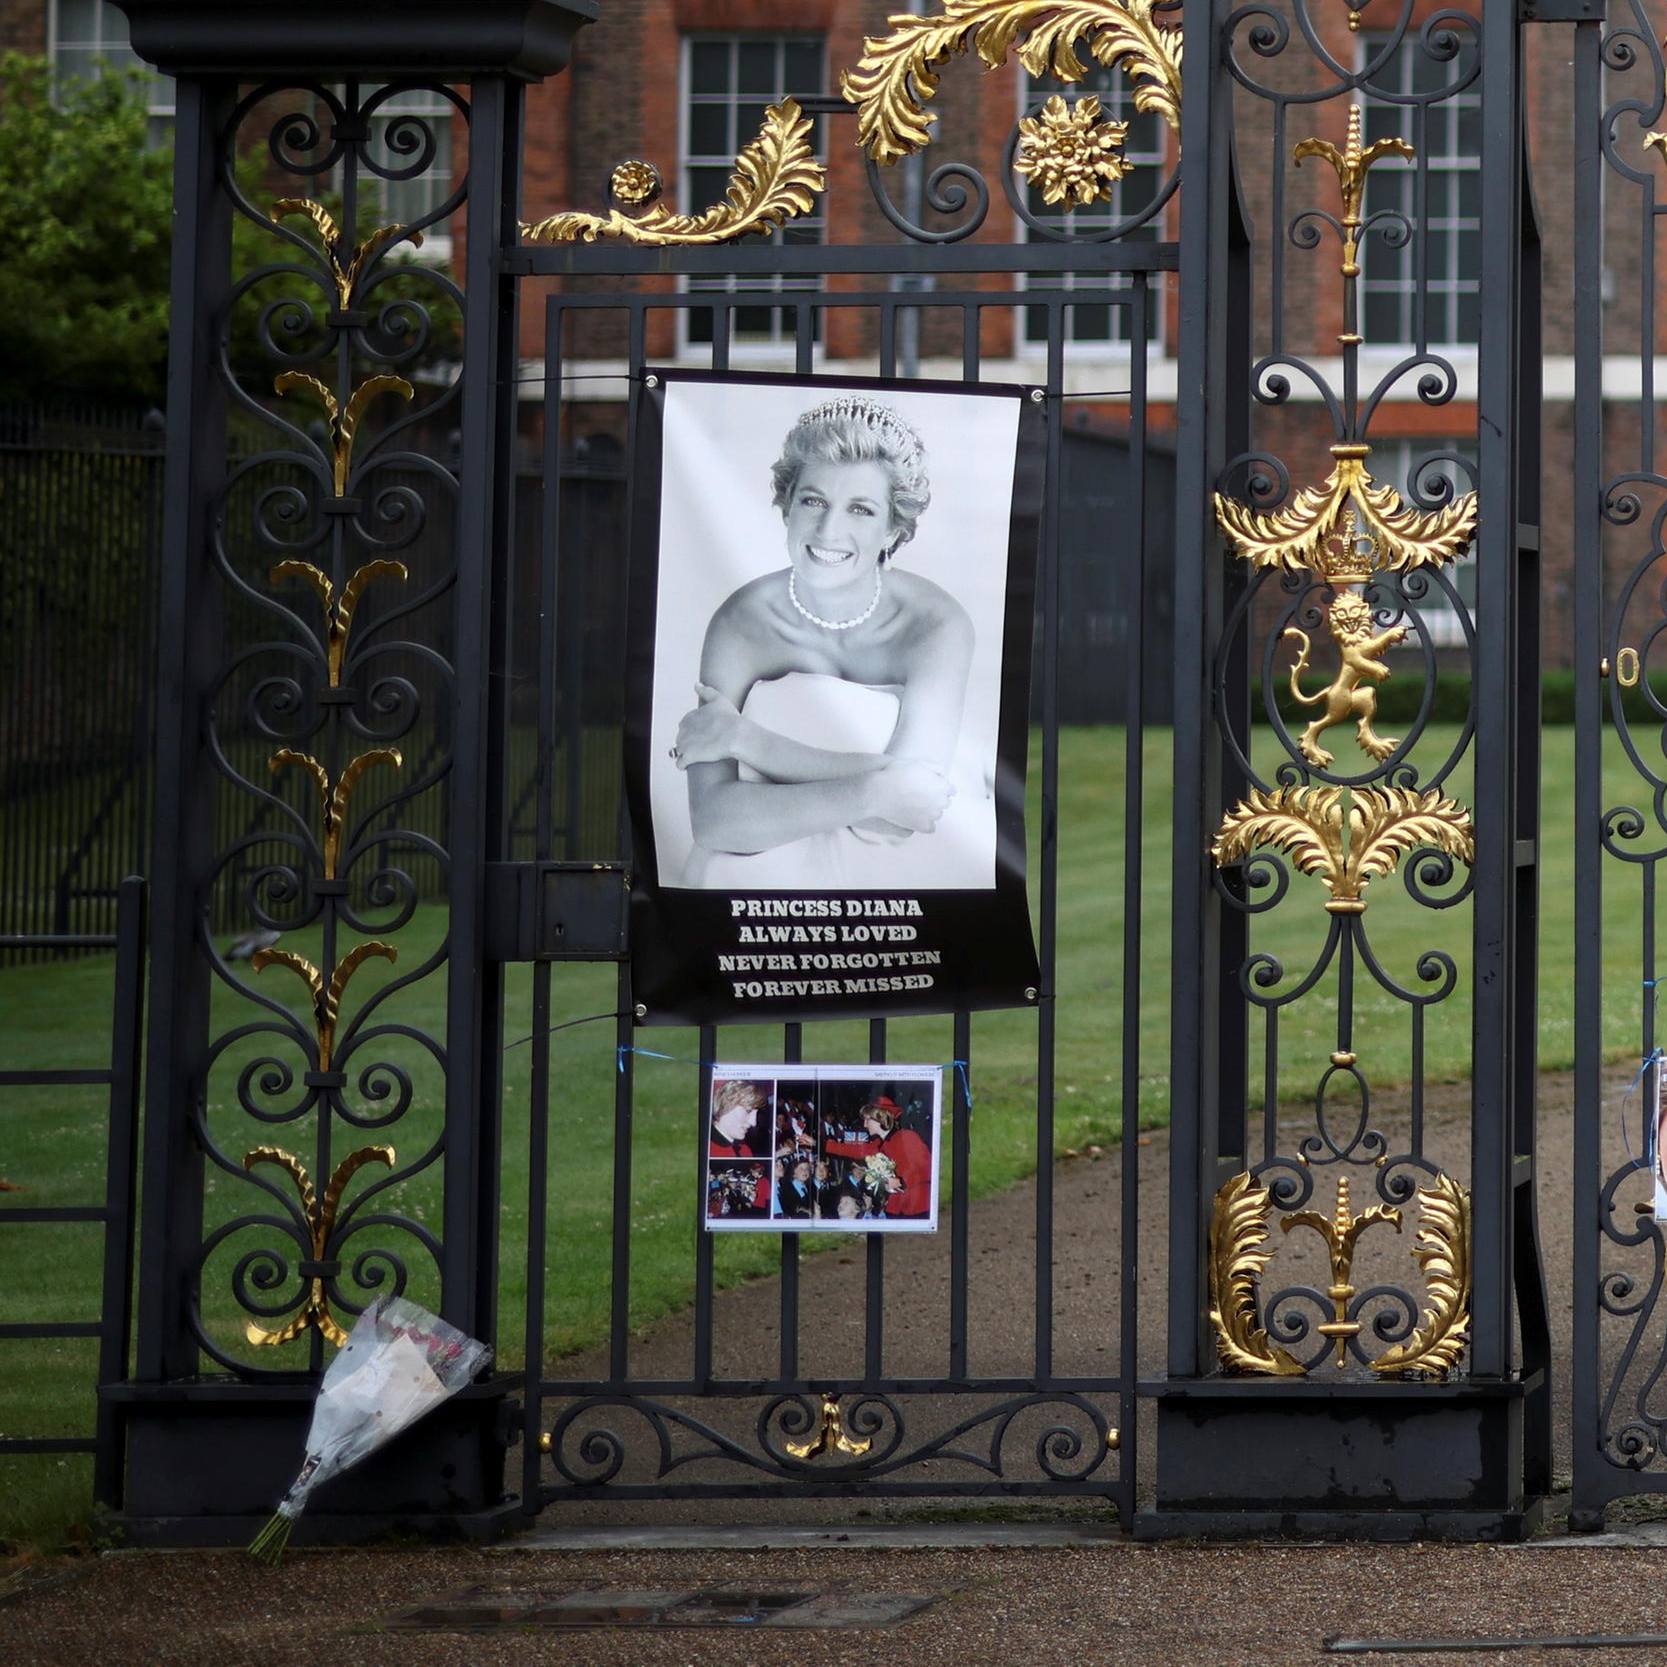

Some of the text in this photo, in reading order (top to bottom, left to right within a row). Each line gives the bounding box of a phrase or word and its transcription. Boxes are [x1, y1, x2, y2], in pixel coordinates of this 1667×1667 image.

[730, 899, 924, 917] PRINCESS DIANA
[738, 925, 918, 943] ALWAYS LOVED
[717, 950, 941, 972] NEVER FORGOTTEN
[732, 974, 935, 998] FOREVER MISSED
